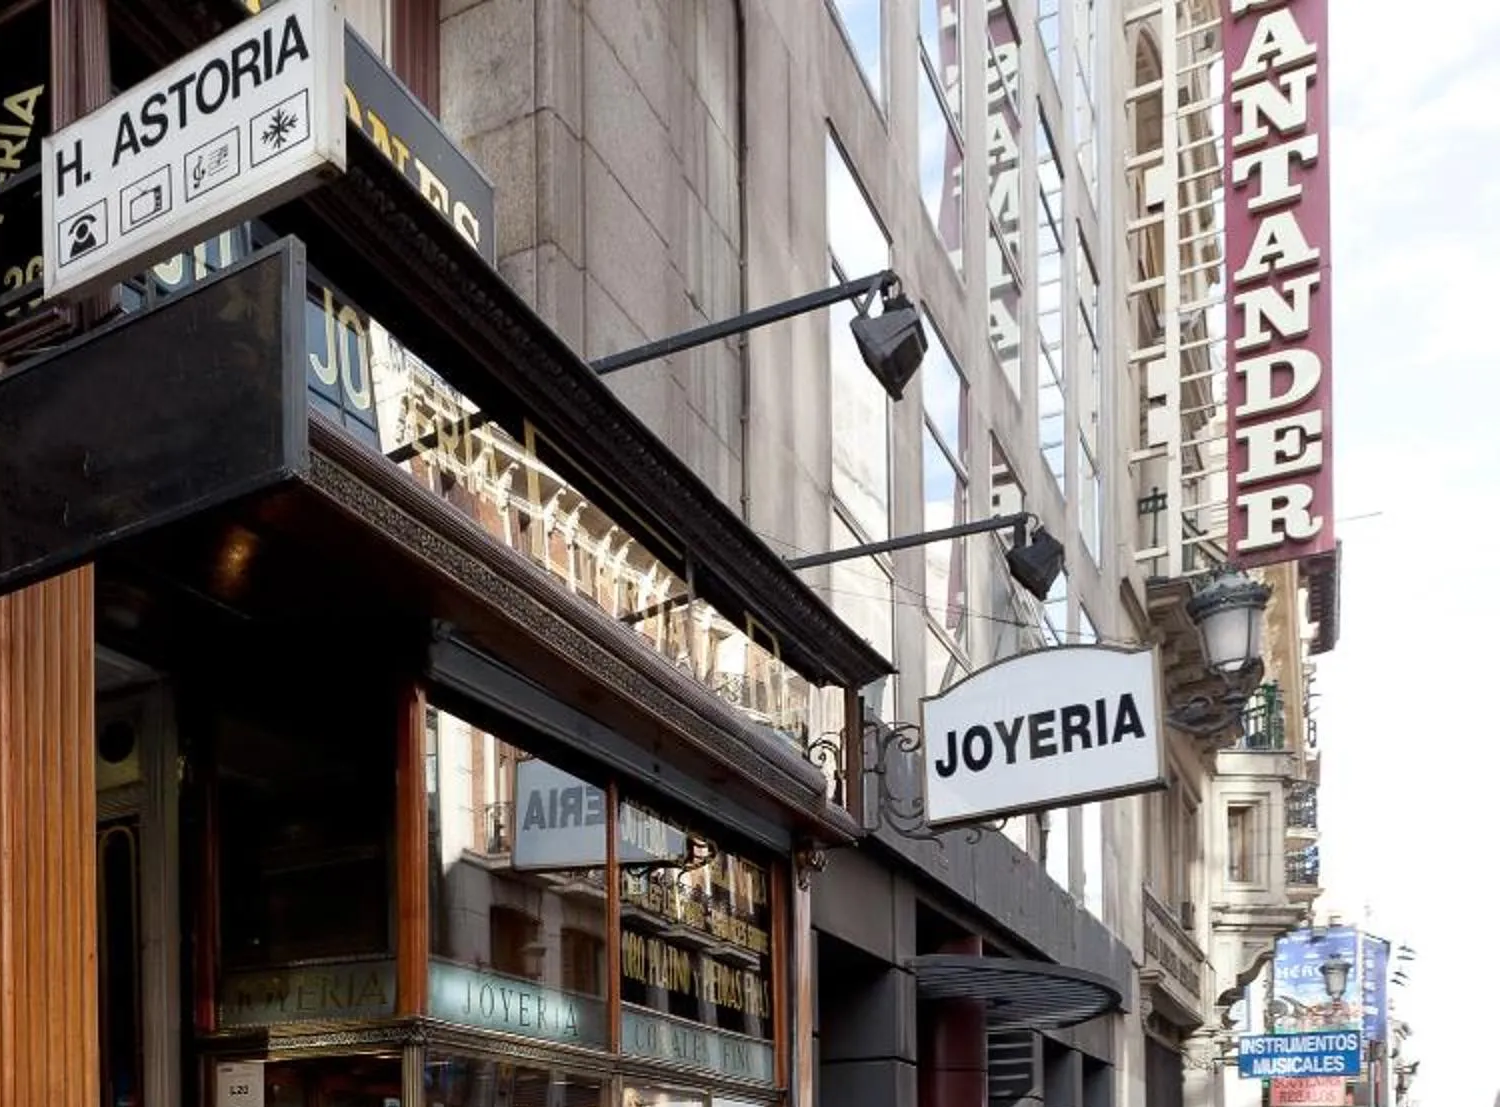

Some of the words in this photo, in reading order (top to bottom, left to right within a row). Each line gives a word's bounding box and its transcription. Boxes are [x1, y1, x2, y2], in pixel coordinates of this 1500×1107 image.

[56, 140, 91, 197] H.
[112, 15, 309, 167] ASTORIA
[1231, 0, 1323, 551] ANTANDER
[935, 693, 1145, 777] JOYERIA
[462, 982, 580, 1037] JOYERIA
[1241, 1033, 1358, 1055] INSTRUMENTOS
[1253, 1056, 1345, 1075] MUSICALES
